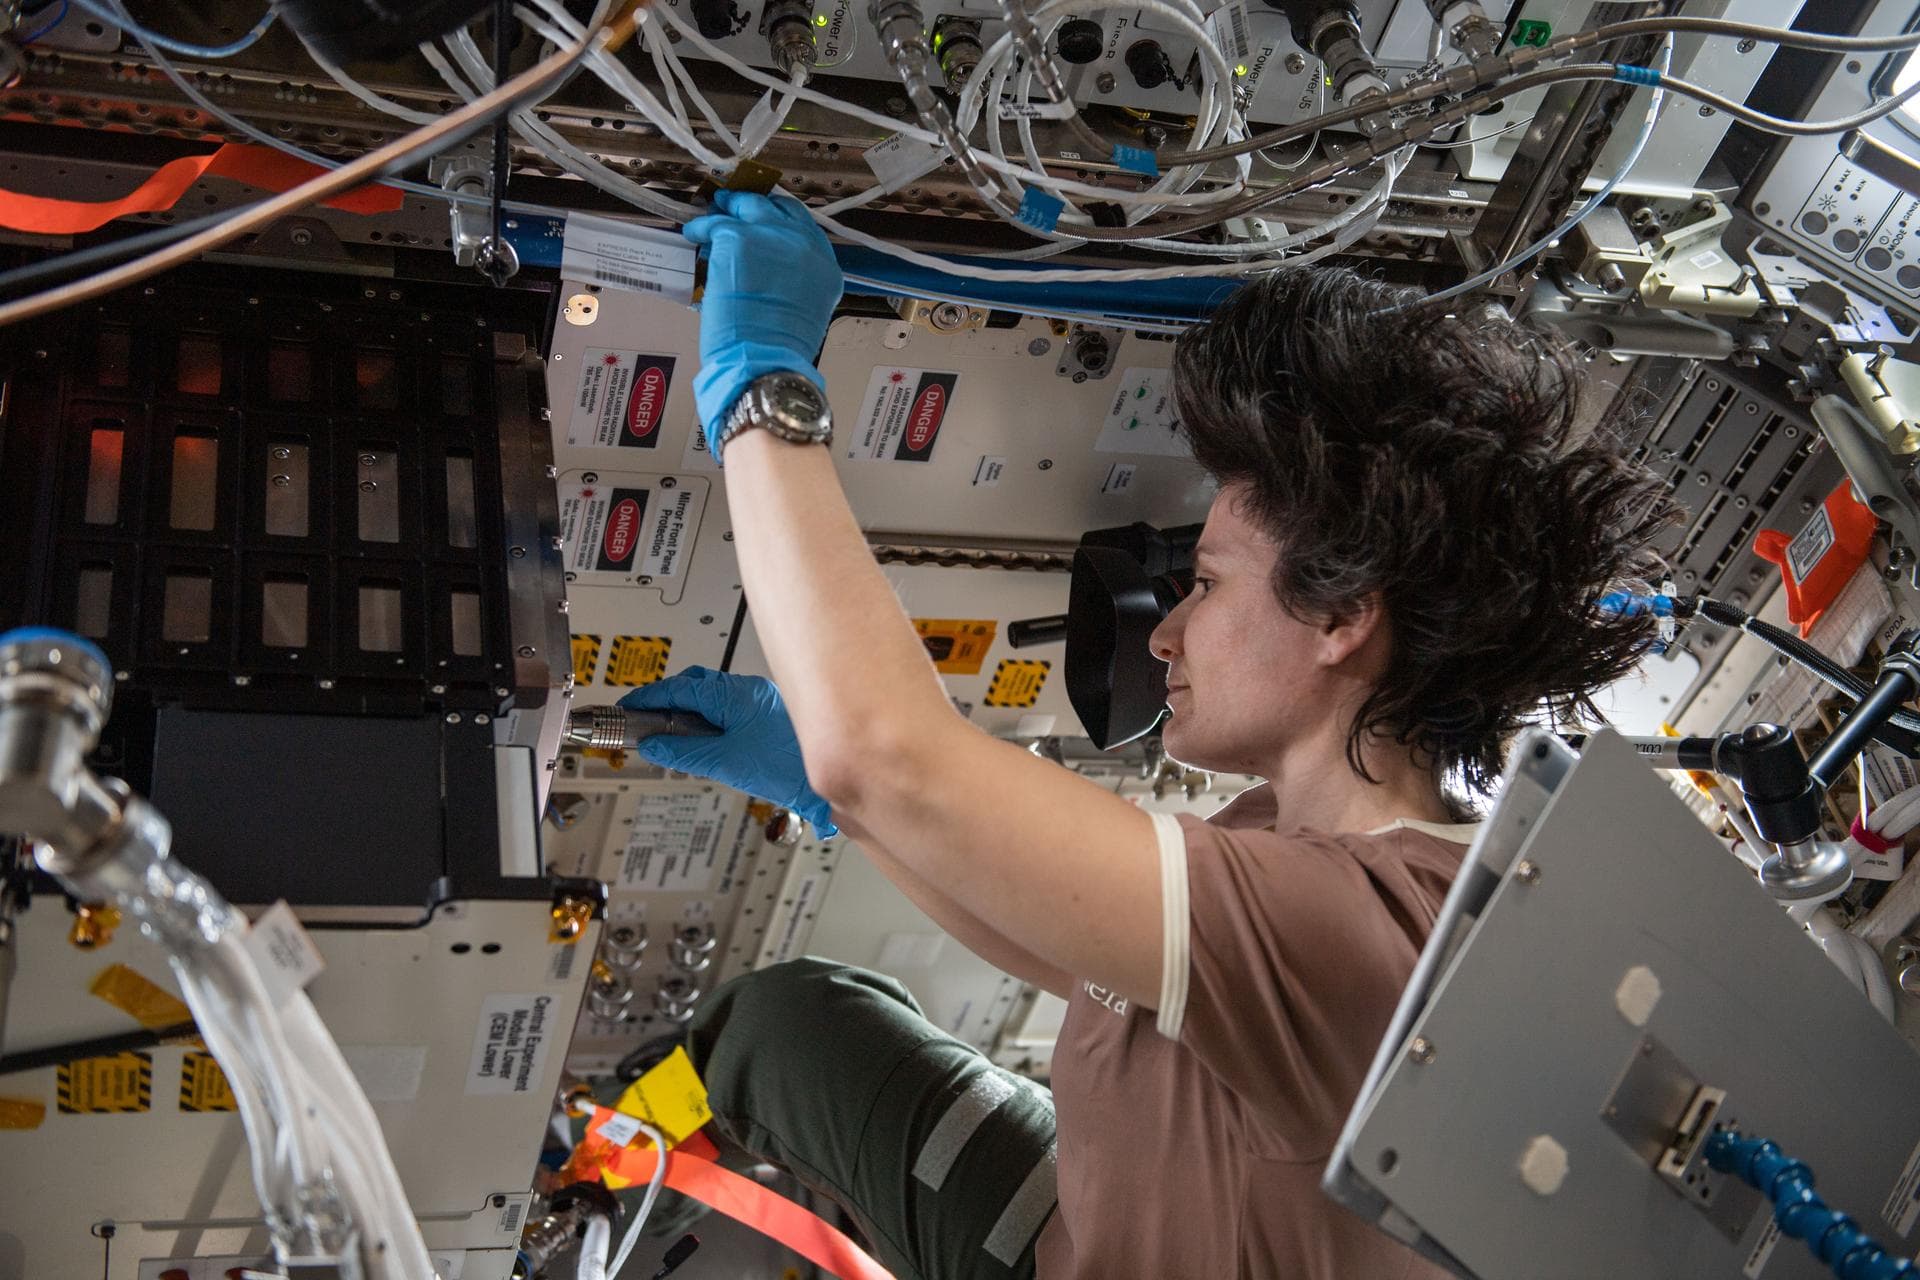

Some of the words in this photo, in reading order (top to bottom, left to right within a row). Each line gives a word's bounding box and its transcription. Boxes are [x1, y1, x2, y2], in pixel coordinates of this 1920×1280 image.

[828, 0, 848, 40] Power
[824, 41, 839, 57] J6
[1247, 46, 1272, 84] Power
[1298, 95, 1312, 110] J5
[1838, 168, 1852, 184] MAX
[1855, 179, 1867, 193] MIN
[1886, 227, 1907, 252] MODE
[610, 367, 619, 385] AVOID
[618, 368, 629, 395] INVISIBLE
[604, 386, 615, 416] EXPOSURE
[613, 396, 622, 415] LASER
[634, 375, 658, 427] DANGER
[893, 387, 902, 403] AVOID
[900, 387, 911, 406] LASER
[1112, 390, 1127, 416] CLOSED
[1154, 396, 1166, 414] OPEN
[607, 416, 617, 445] RADIATION
[884, 405, 896, 432] EXPOSURE
[891, 407, 904, 435] RADIATION
[911, 391, 939, 443] DANGER
[598, 426, 606, 441] BEAM
[876, 442, 885, 457] BEAM
[674, 492, 690, 519] Mirror
[611, 506, 633, 554] DANGER
[650, 509, 672, 556] Protection
[667, 523, 682, 547] Front
[660, 550, 675, 574] Panel
[1882, 614, 1906, 641] RPDA
[488, 1013, 508, 1040] (CEM
[506, 1010, 529, 1045] Module
[528, 997, 551, 1033] Central
[477, 1043, 502, 1075] Lower)
[499, 1049, 523, 1078] Lower
[513, 1037, 541, 1090] Experiment
